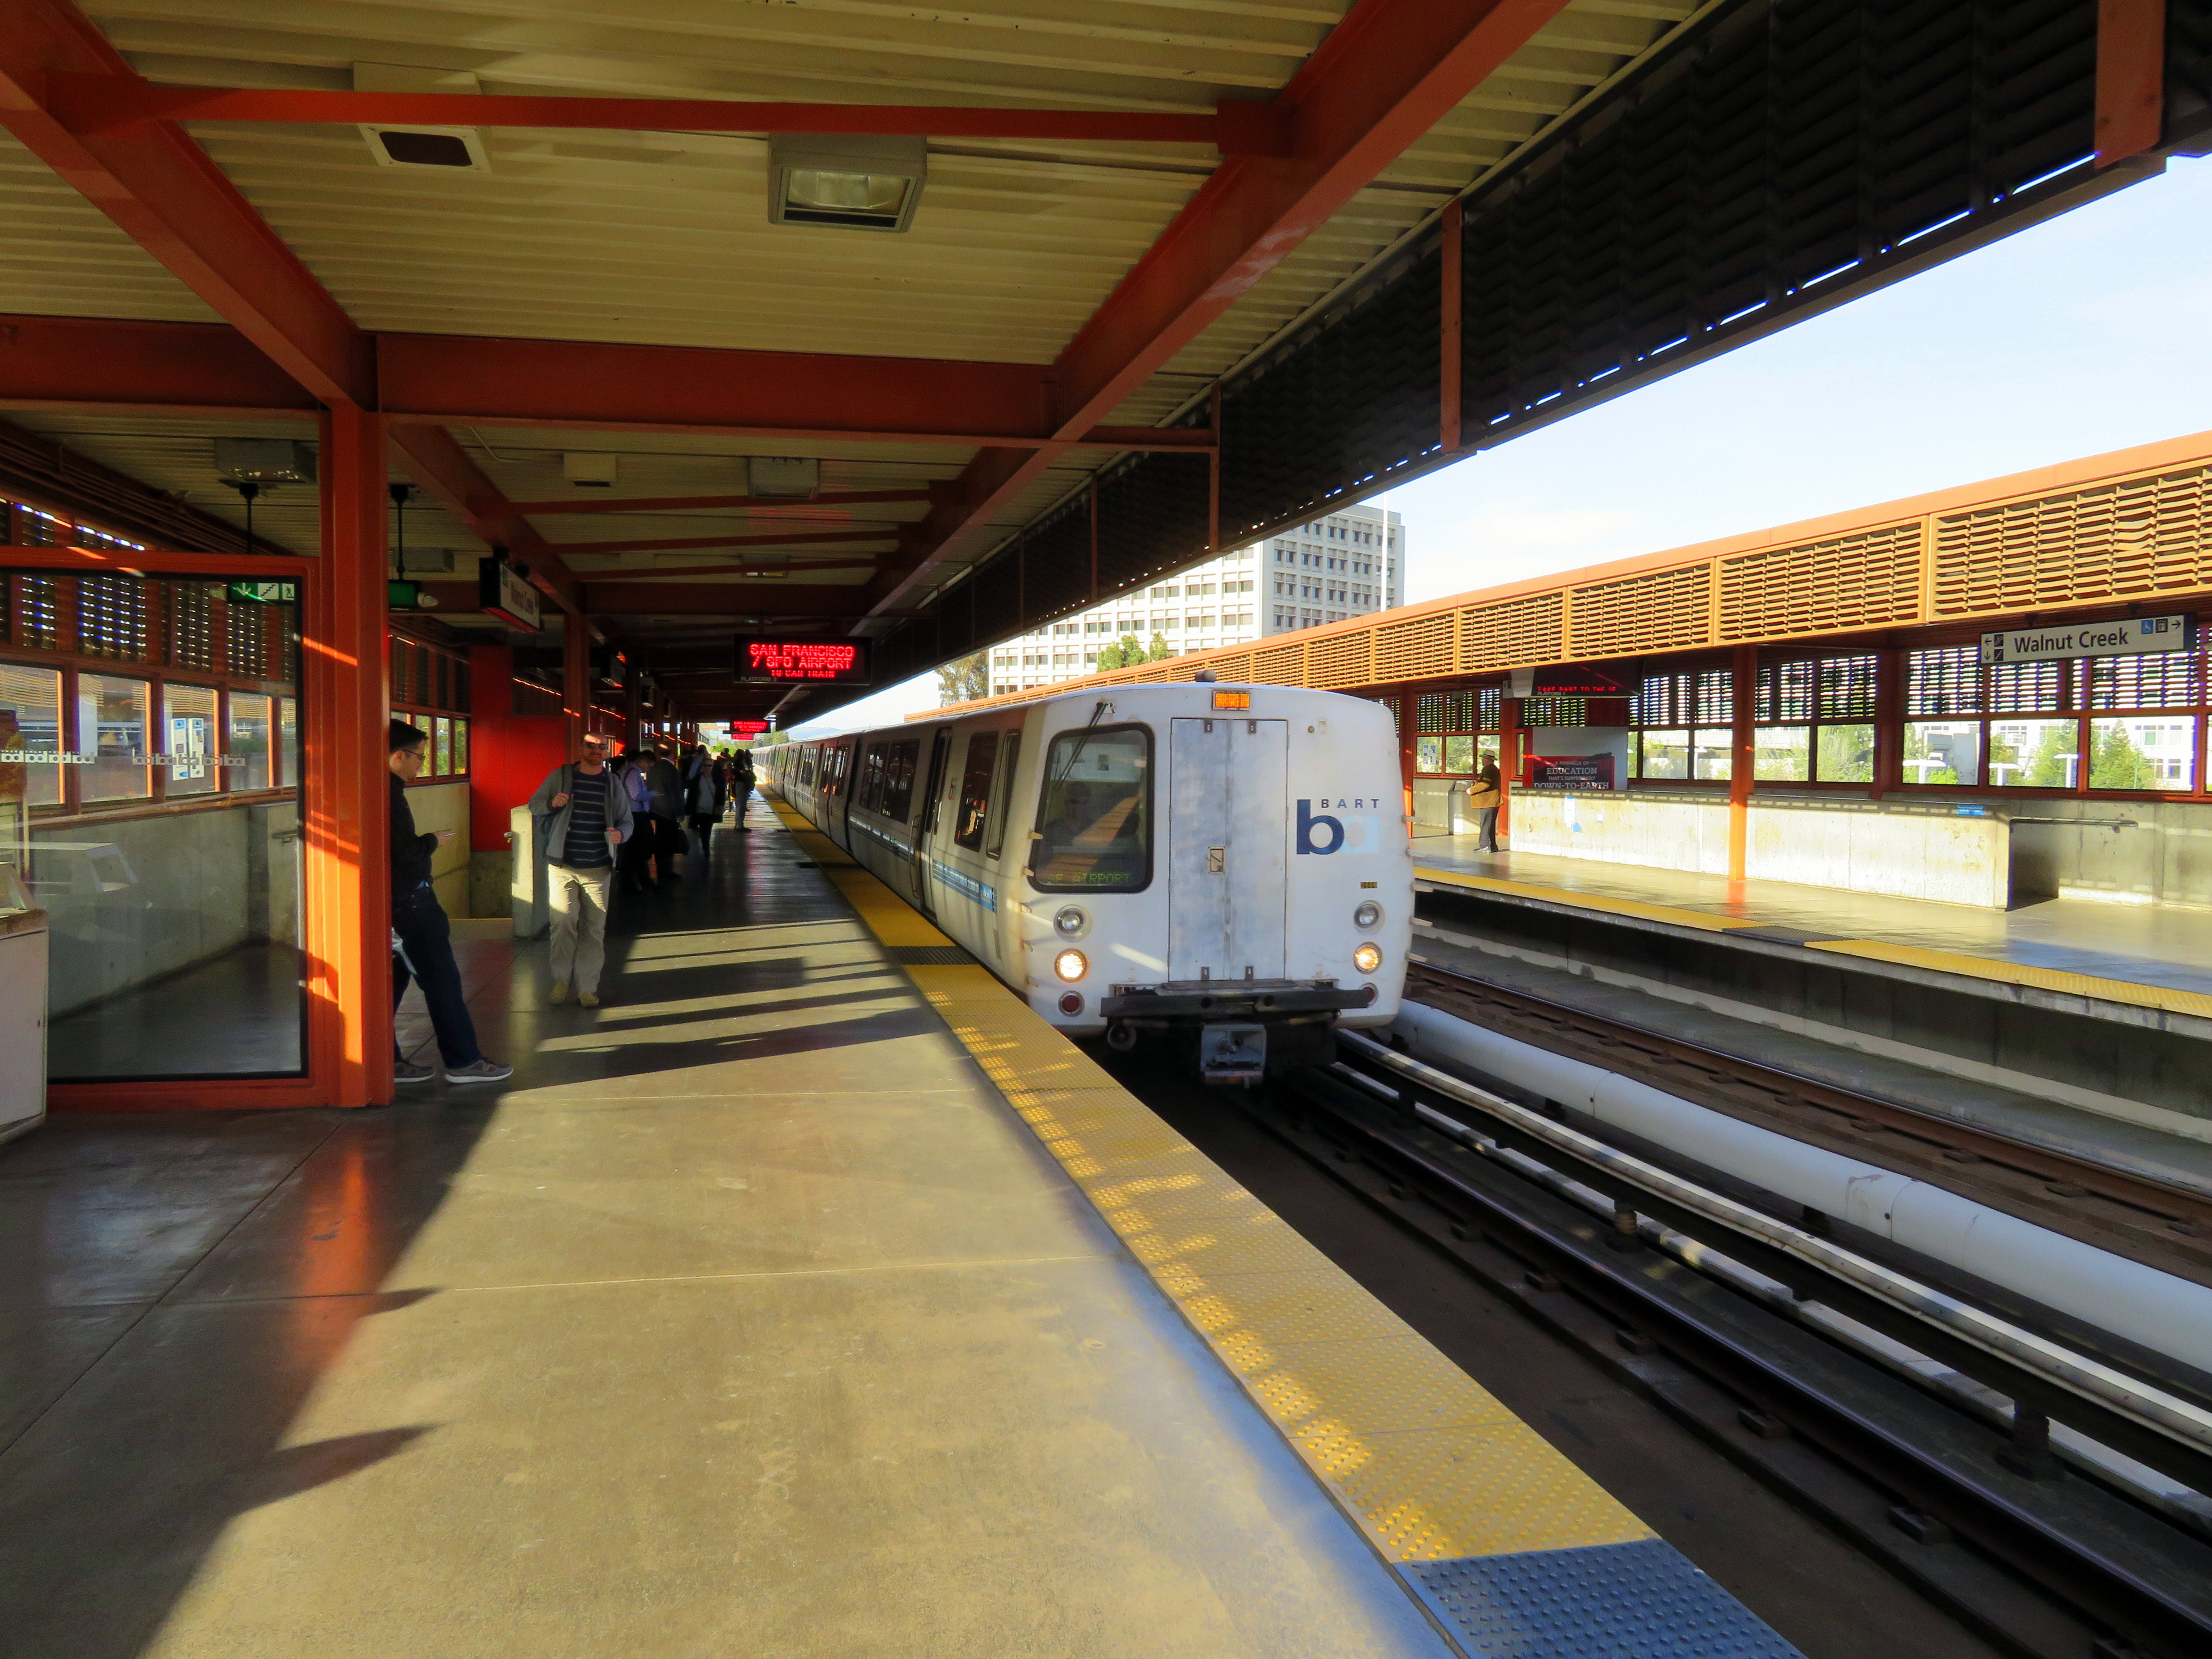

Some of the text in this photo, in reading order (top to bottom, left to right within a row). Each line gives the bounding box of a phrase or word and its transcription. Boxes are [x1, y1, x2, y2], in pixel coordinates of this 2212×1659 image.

[2014, 627, 2129, 653] Walnut Creek
[750, 644, 854, 657] SAN FRANCISCO
[766, 656, 794, 668] SFO
[799, 657, 853, 669] AIRPORT
[1321, 799, 1379, 808] BART
[1072, 873, 1130, 883] AIRPORT
